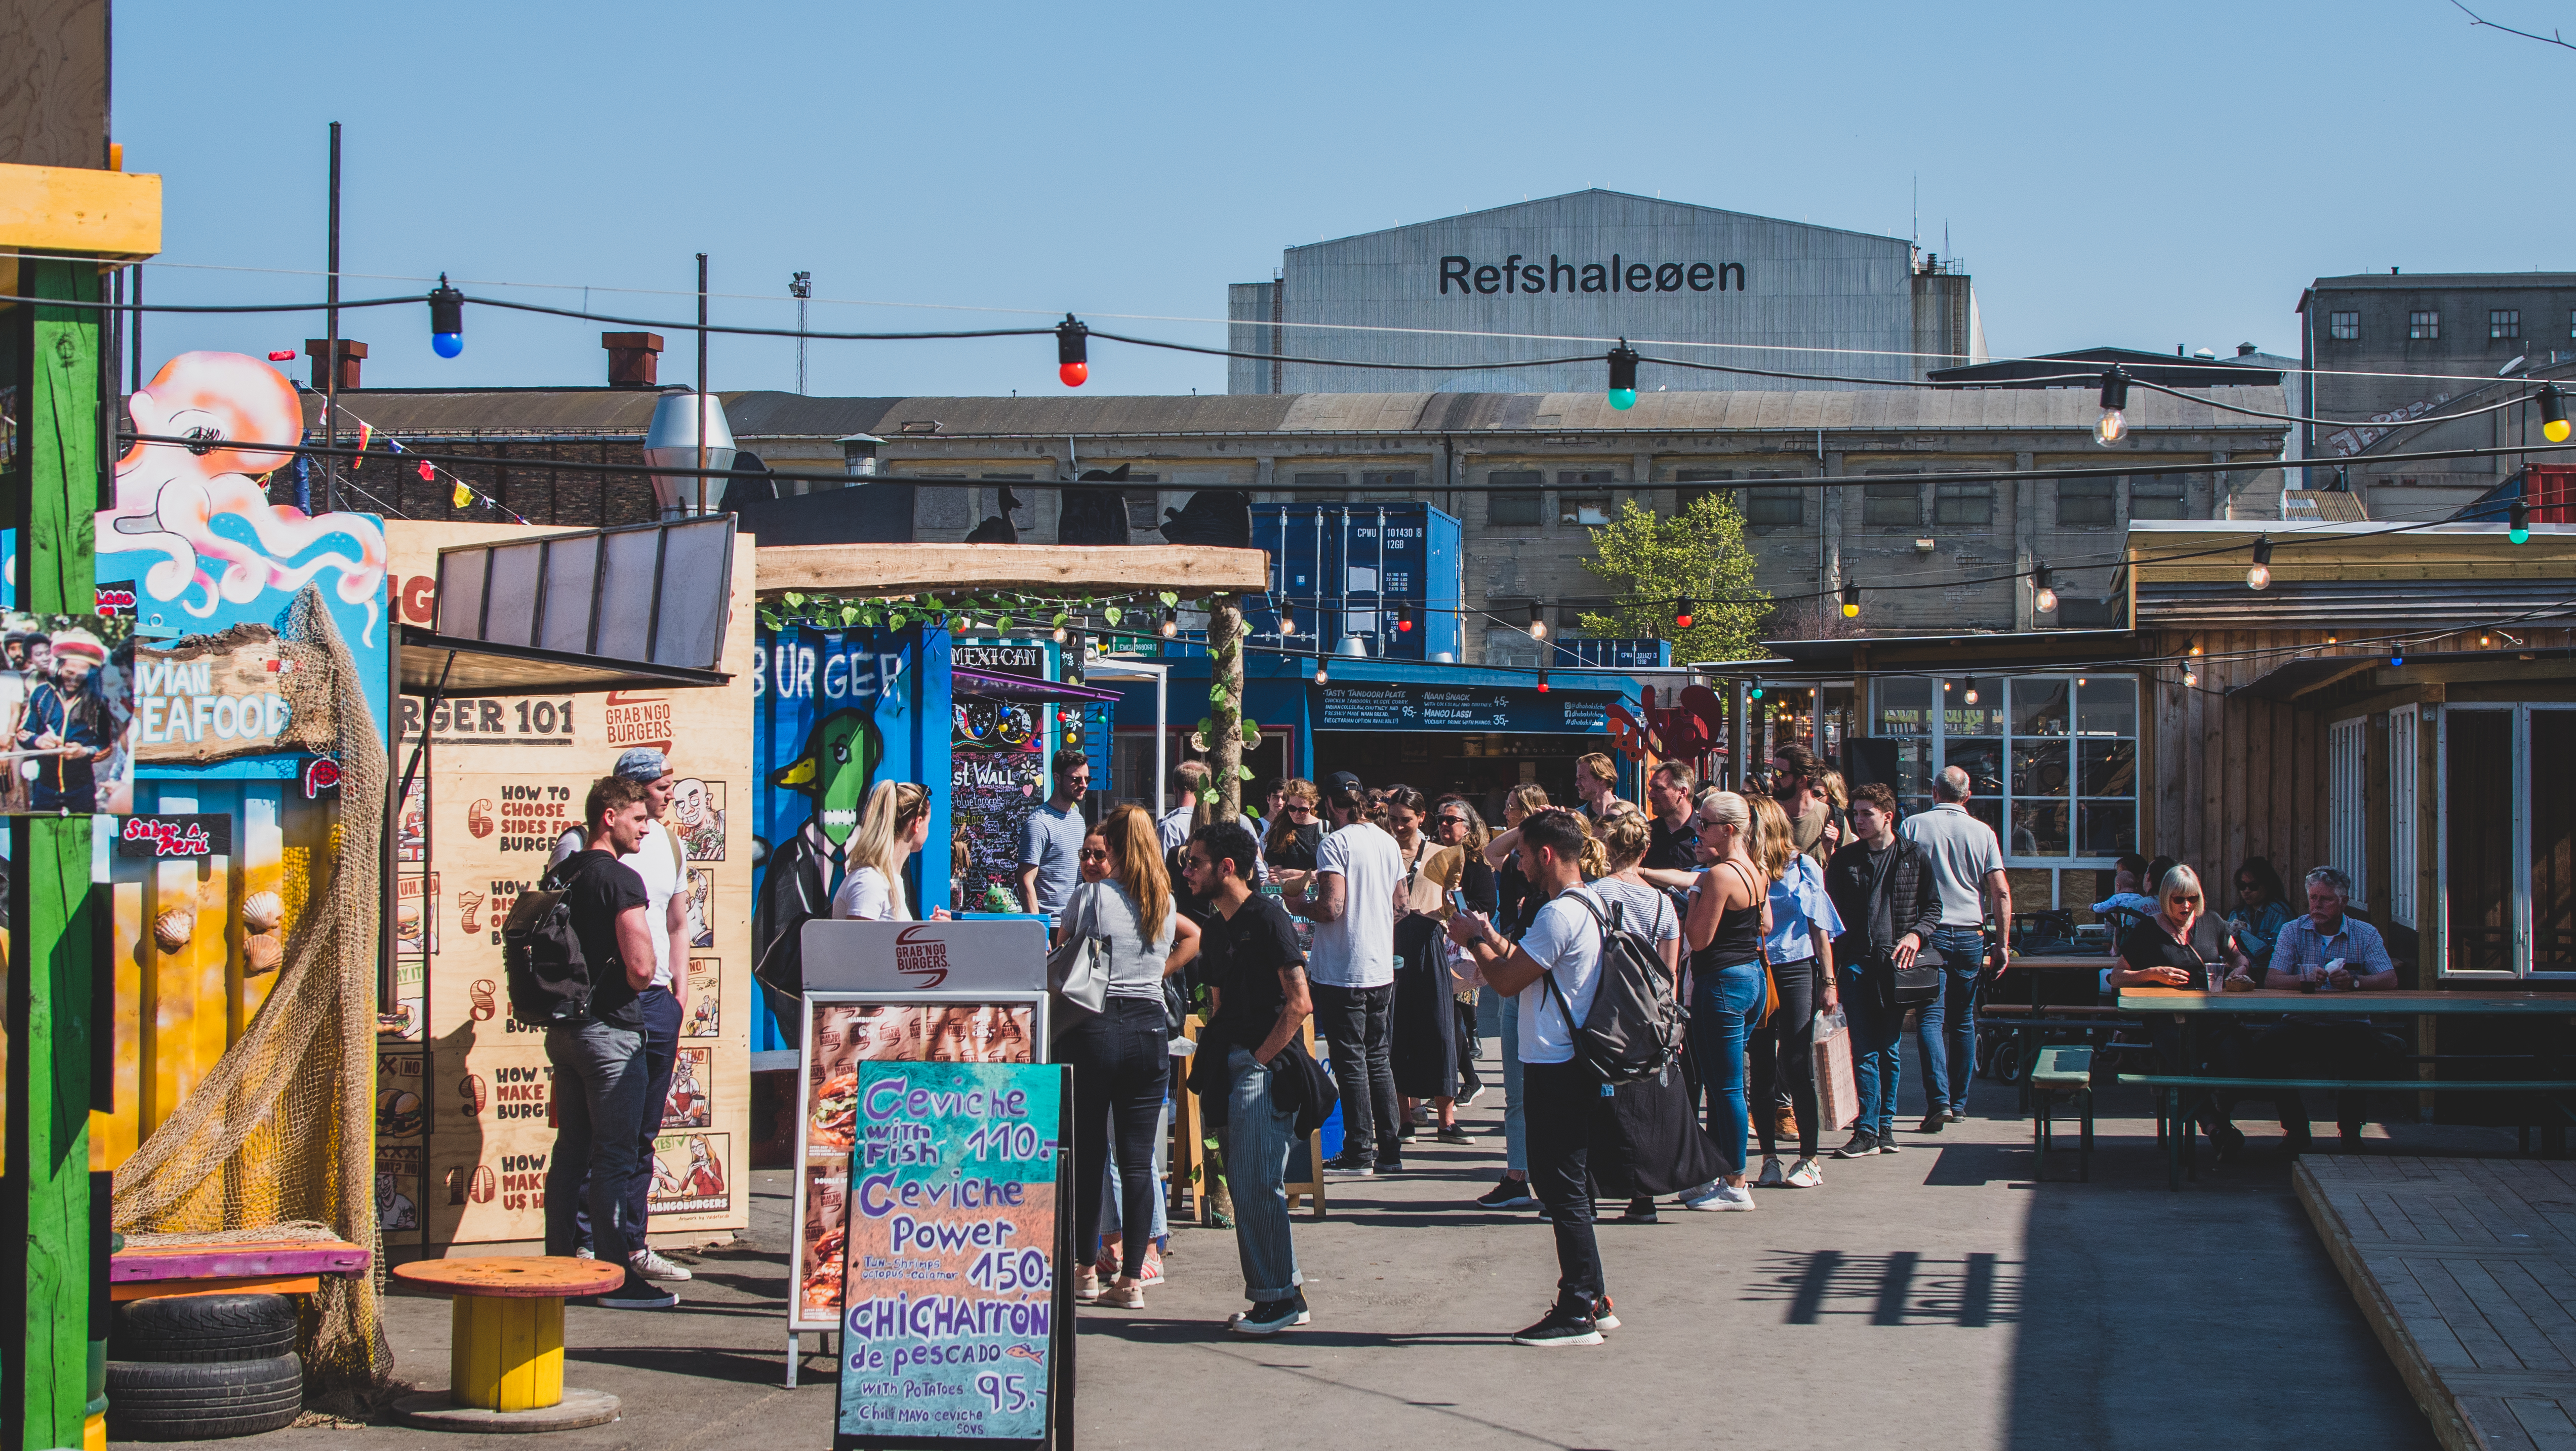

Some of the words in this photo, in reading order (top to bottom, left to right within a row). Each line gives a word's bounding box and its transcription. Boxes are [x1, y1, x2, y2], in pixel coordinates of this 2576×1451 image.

[1440, 253, 1745, 295] Refshaleøen
[1357, 528, 1377, 538] CPWU
[1387, 528, 1413, 538] 101430
[1416, 528, 1422, 538] 8
[1387, 540, 1404, 549] 12GB
[951, 647, 1036, 666] MEXICAN
[754, 643, 902, 701] BURGER
[1324, 689, 1345, 697] TASTY
[1348, 689, 1384, 698] TANDOORI
[1385, 690, 1406, 698] PLATE
[1424, 692, 1444, 700] NAAN
[1445, 692, 1470, 701] SNACK
[1424, 708, 1450, 718] MANGO
[1451, 709, 1472, 718] LASSI
[1571, 702, 1605, 710] @dhabakitche
[514, 699, 574, 734] 101
[607, 720, 672, 743] BURGERS
[973, 761, 1015, 785] WALL
[502, 785, 542, 800] HOW
[547, 786, 570, 801] TO
[468, 798, 494, 838] 6
[501, 802, 565, 817] CHOOSE
[124, 818, 181, 841] Sabor
[501, 819, 547, 834] SIDES
[156, 832, 211, 856] Perú
[500, 836, 557, 852] BURGE
[491, 880, 531, 895] HOW
[459, 891, 485, 934] 7
[897, 955, 947, 971] BURGERS
[470, 979, 496, 1021] 8
[506, 1019, 547, 1033] BUR
[405, 1060, 420, 1075] NO
[496, 1067, 537, 1083] HOW
[544, 1067, 554, 1081] T
[459, 1074, 487, 1116] 9
[496, 1084, 544, 1102] MAKE
[863, 1075, 1027, 1120] Ceviche
[655, 1137, 672, 1150] YES
[502, 1154, 547, 1172] HOW
[444, 1165, 496, 1205] 10
[859, 1167, 1024, 1219] Ceviche
[503, 1193, 527, 1211] US
[891, 1213, 1017, 1256] Power
[849, 1344, 884, 1371] de
